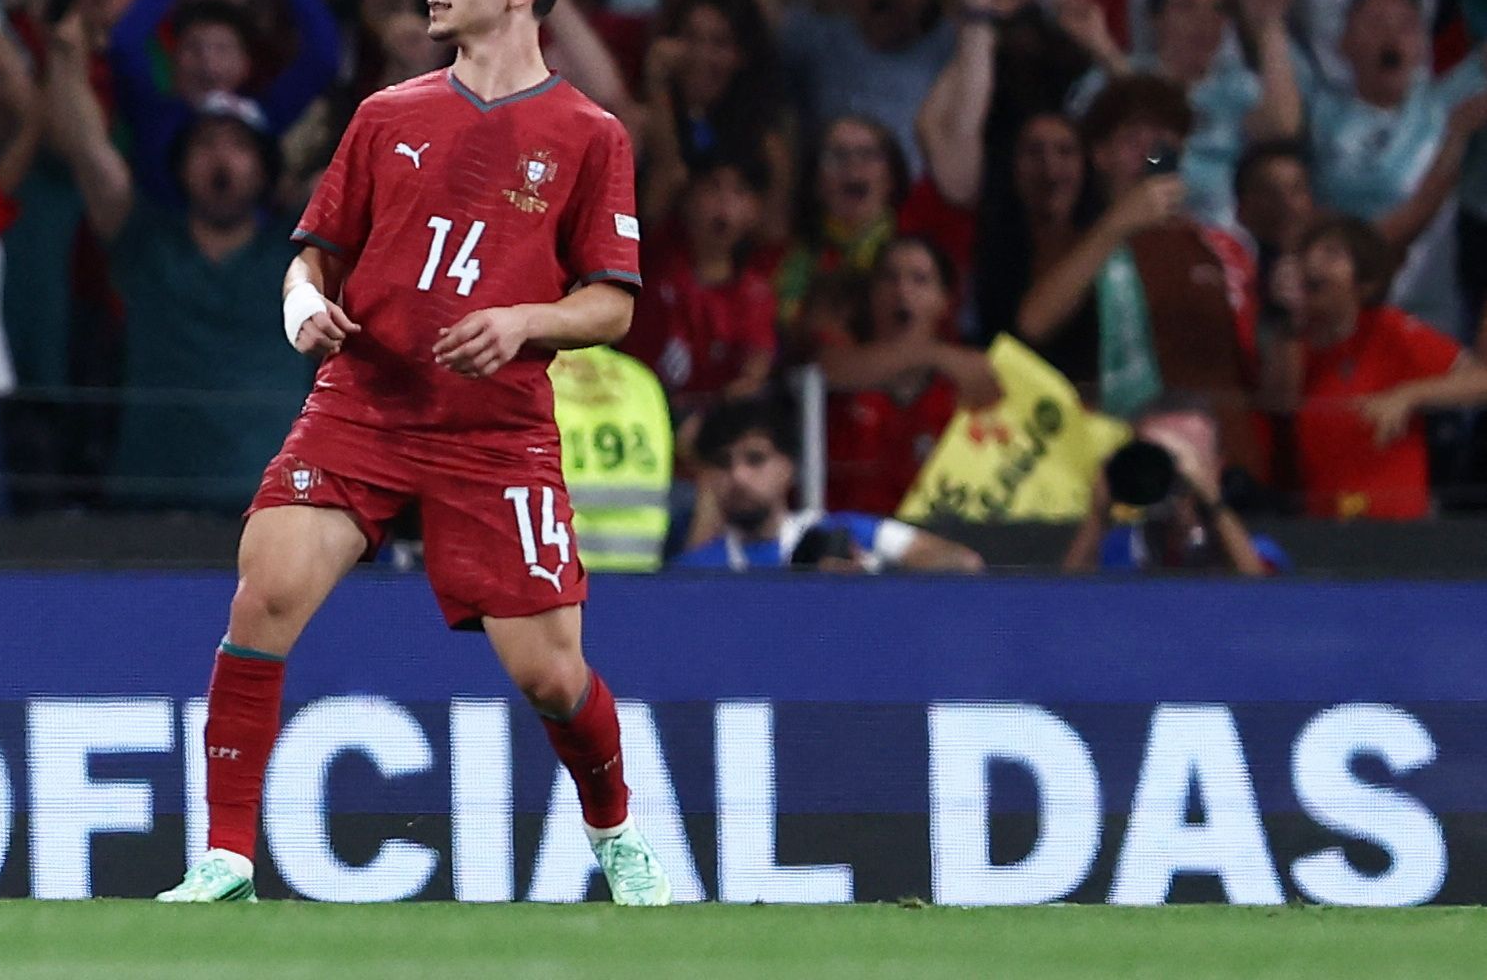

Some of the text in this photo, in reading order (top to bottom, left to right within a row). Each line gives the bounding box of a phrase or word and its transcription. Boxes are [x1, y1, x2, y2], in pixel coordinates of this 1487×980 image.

[416, 215, 486, 297] 14
[503, 486, 570, 565] 14
[927, 700, 1446, 908] DAS
